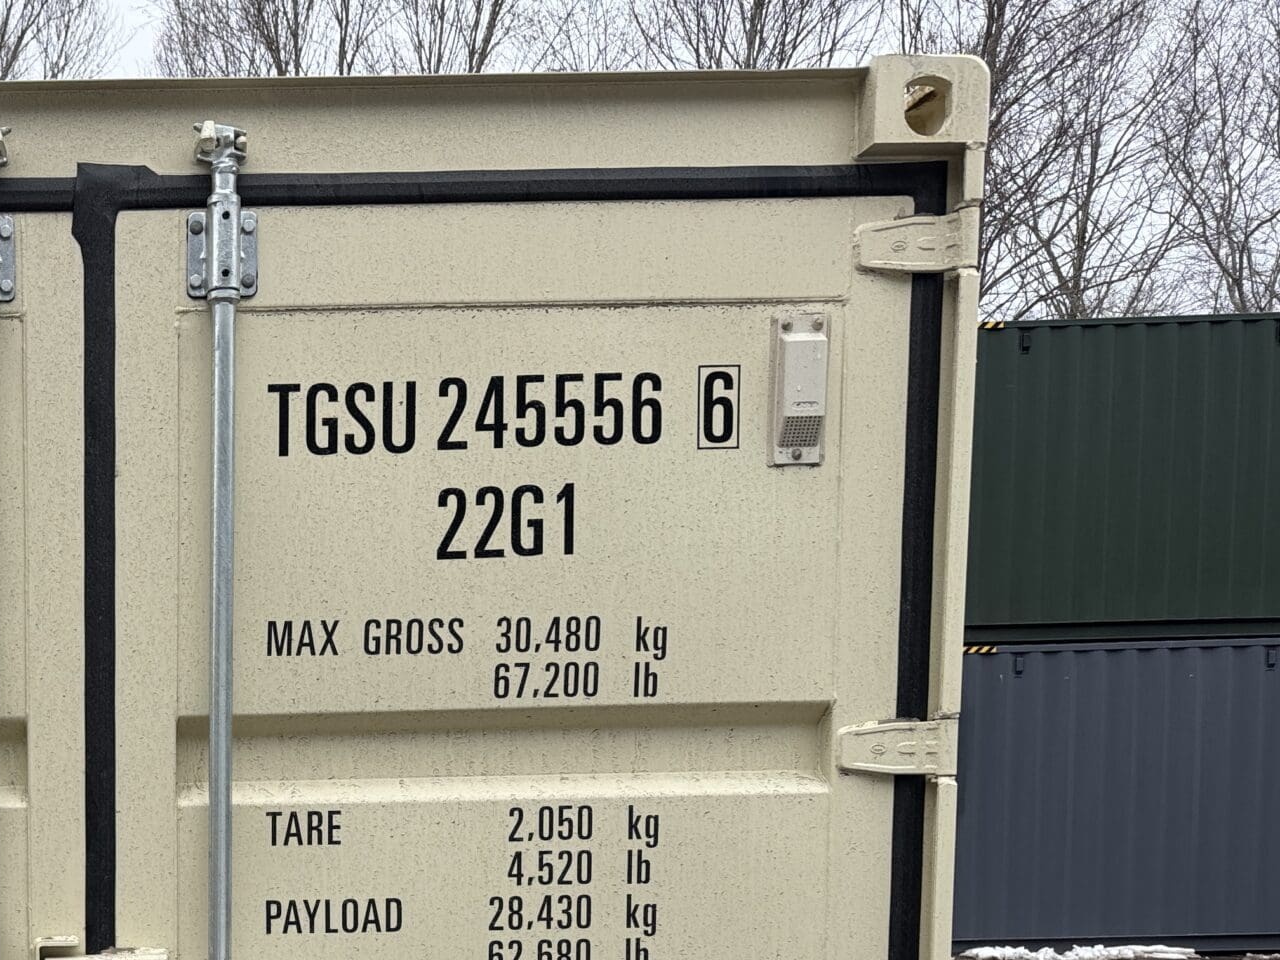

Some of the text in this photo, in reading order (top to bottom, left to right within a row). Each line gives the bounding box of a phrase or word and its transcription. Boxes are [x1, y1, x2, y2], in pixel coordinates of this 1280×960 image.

[267, 370, 734, 457] TGSU 245556 6
[436, 482, 575, 561] 22G1
[266, 615, 668, 661] MAX GROSS 30,480 kg
[493, 661, 658, 699] 67,200 lb
[265, 804, 659, 849] TARE 2,050 kg
[507, 849, 651, 886] 4,520 lb
[265, 893, 657, 937] PAYLOAD 28,430 kg
